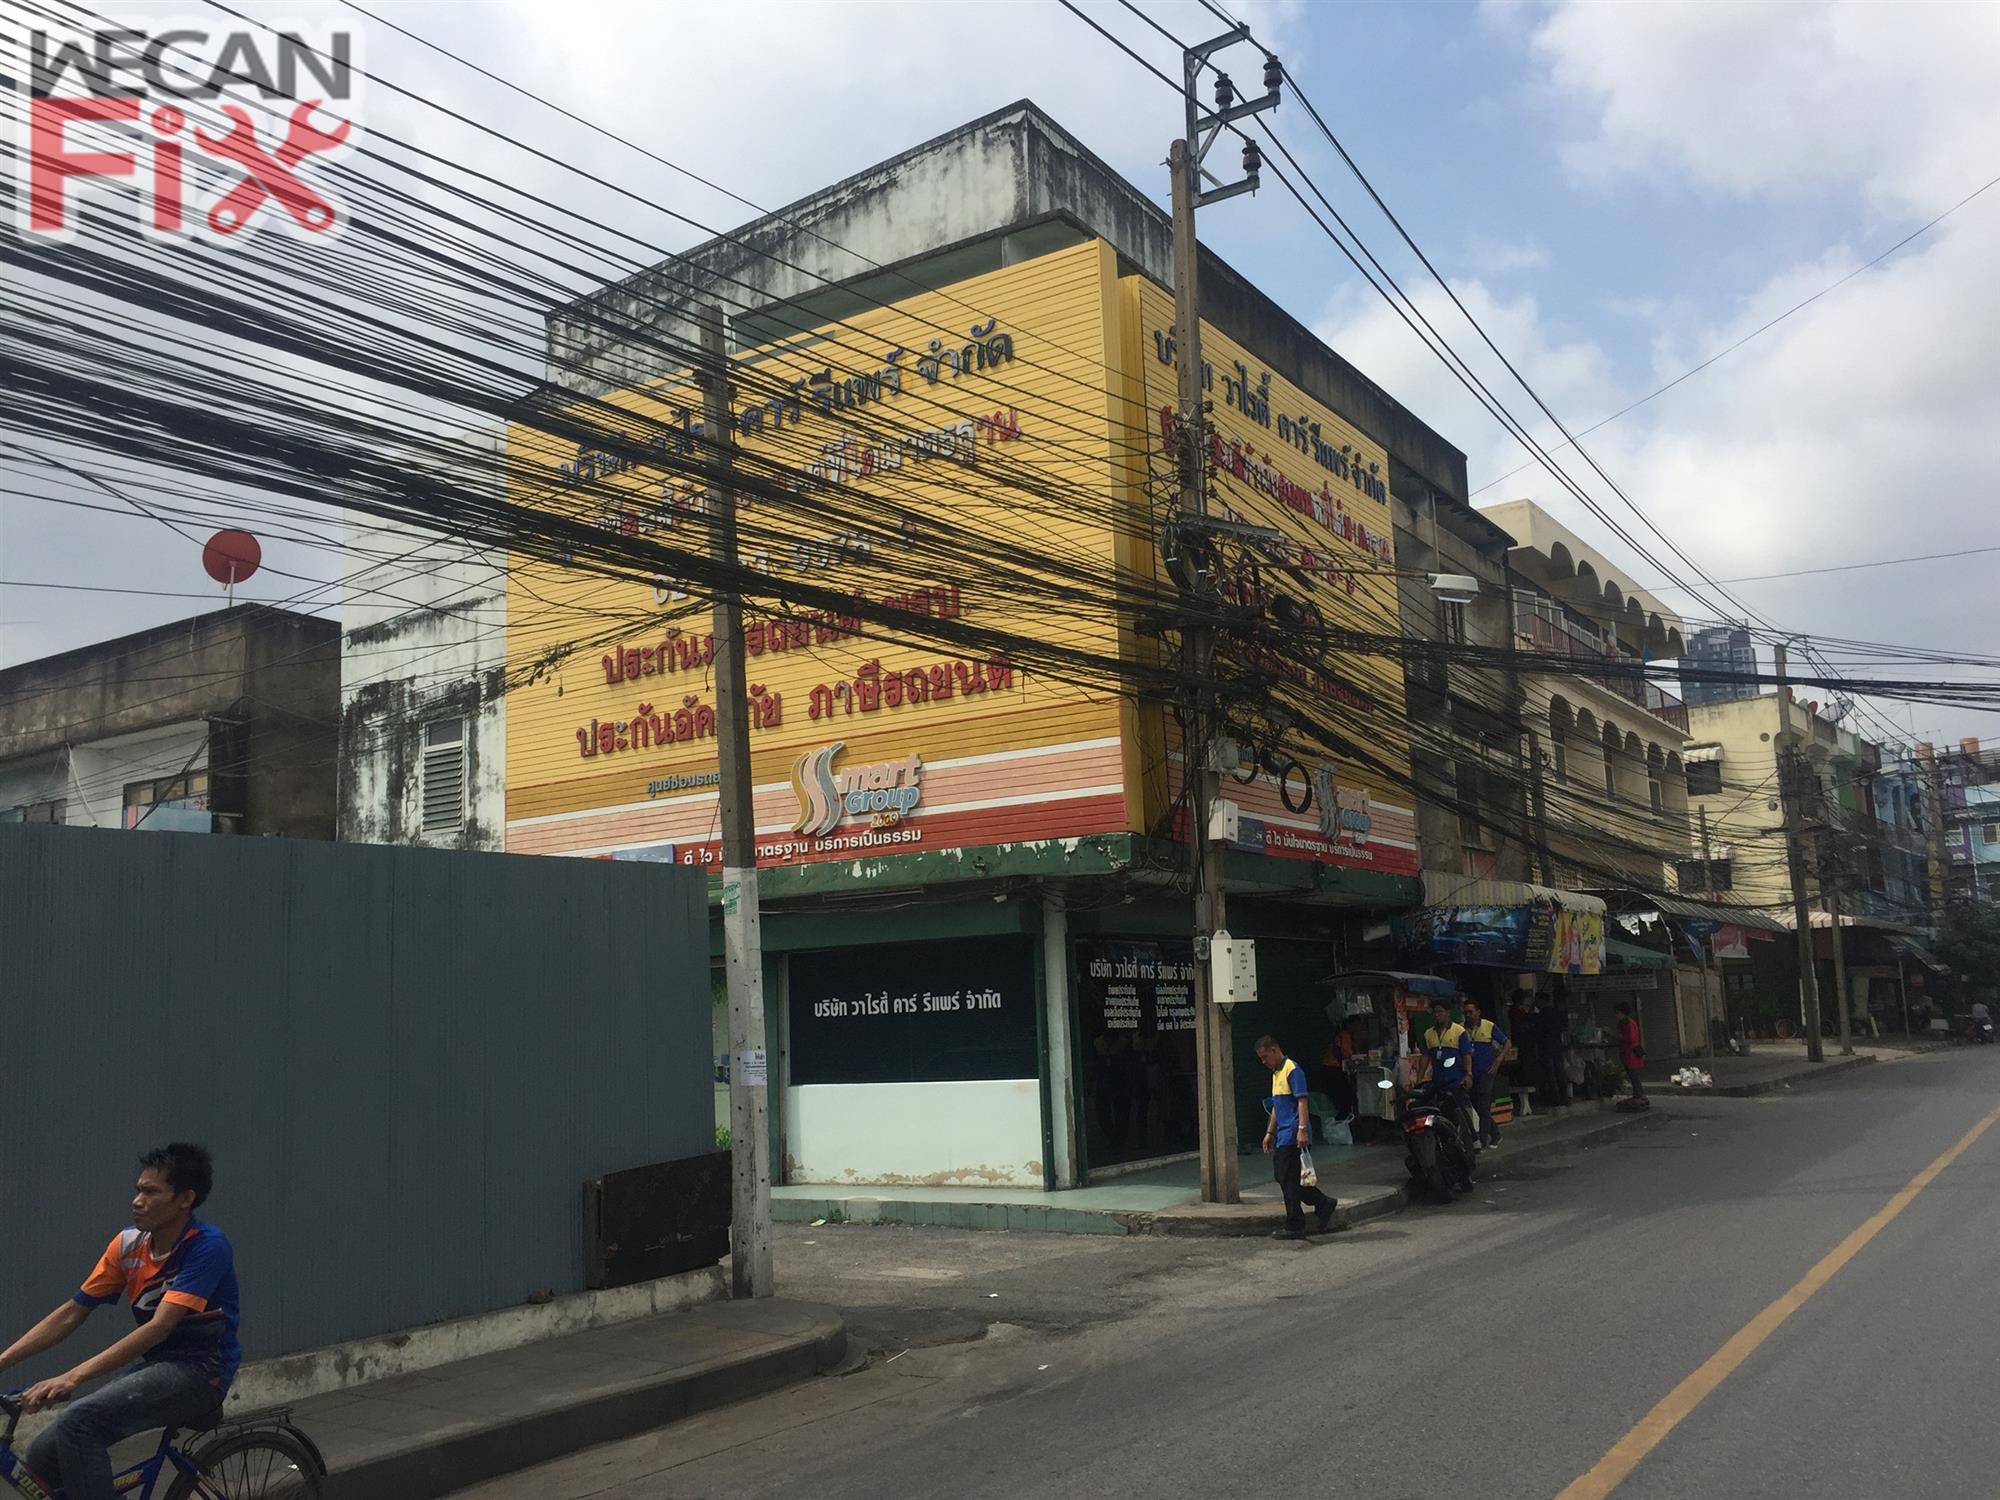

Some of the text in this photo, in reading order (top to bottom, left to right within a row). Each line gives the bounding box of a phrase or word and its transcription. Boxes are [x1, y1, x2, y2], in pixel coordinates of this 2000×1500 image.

[916, 319, 1014, 385] จำกัด
[1220, 359, 1273, 429] วาไรตี้
[843, 786, 921, 815] Group
[870, 812, 901, 829] 2009
[815, 829, 922, 852] บริการเป็นธรรม
[1089, 956, 1195, 981] บริษัท วาไรตี้ คาร์ รีแพร์ จำกั
[814, 987, 1002, 1018] บริษัท วาไรตี้ คาร์ รีแพร์ จำกัด
